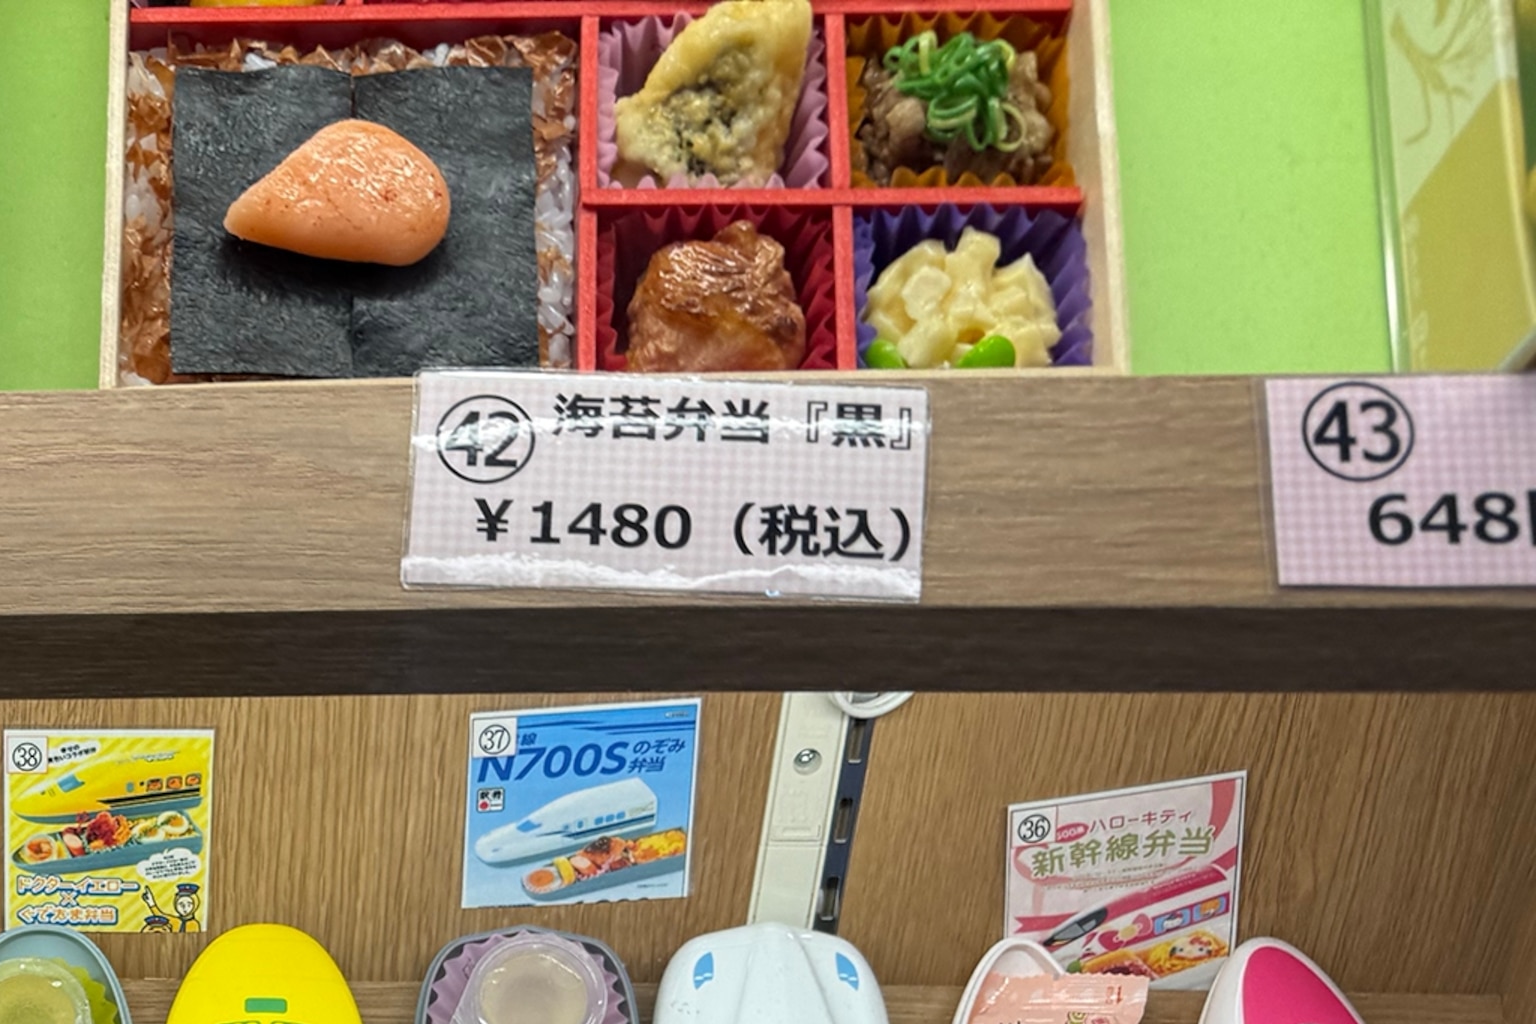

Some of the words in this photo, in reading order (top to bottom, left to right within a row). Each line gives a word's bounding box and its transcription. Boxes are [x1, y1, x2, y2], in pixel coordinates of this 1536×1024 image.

[1368, 488, 1536, 548] 648
[477, 741, 630, 783] N700S
[1090, 809, 1192, 833] ハローキティ
[1031, 827, 1216, 877] 新幹線弁当
